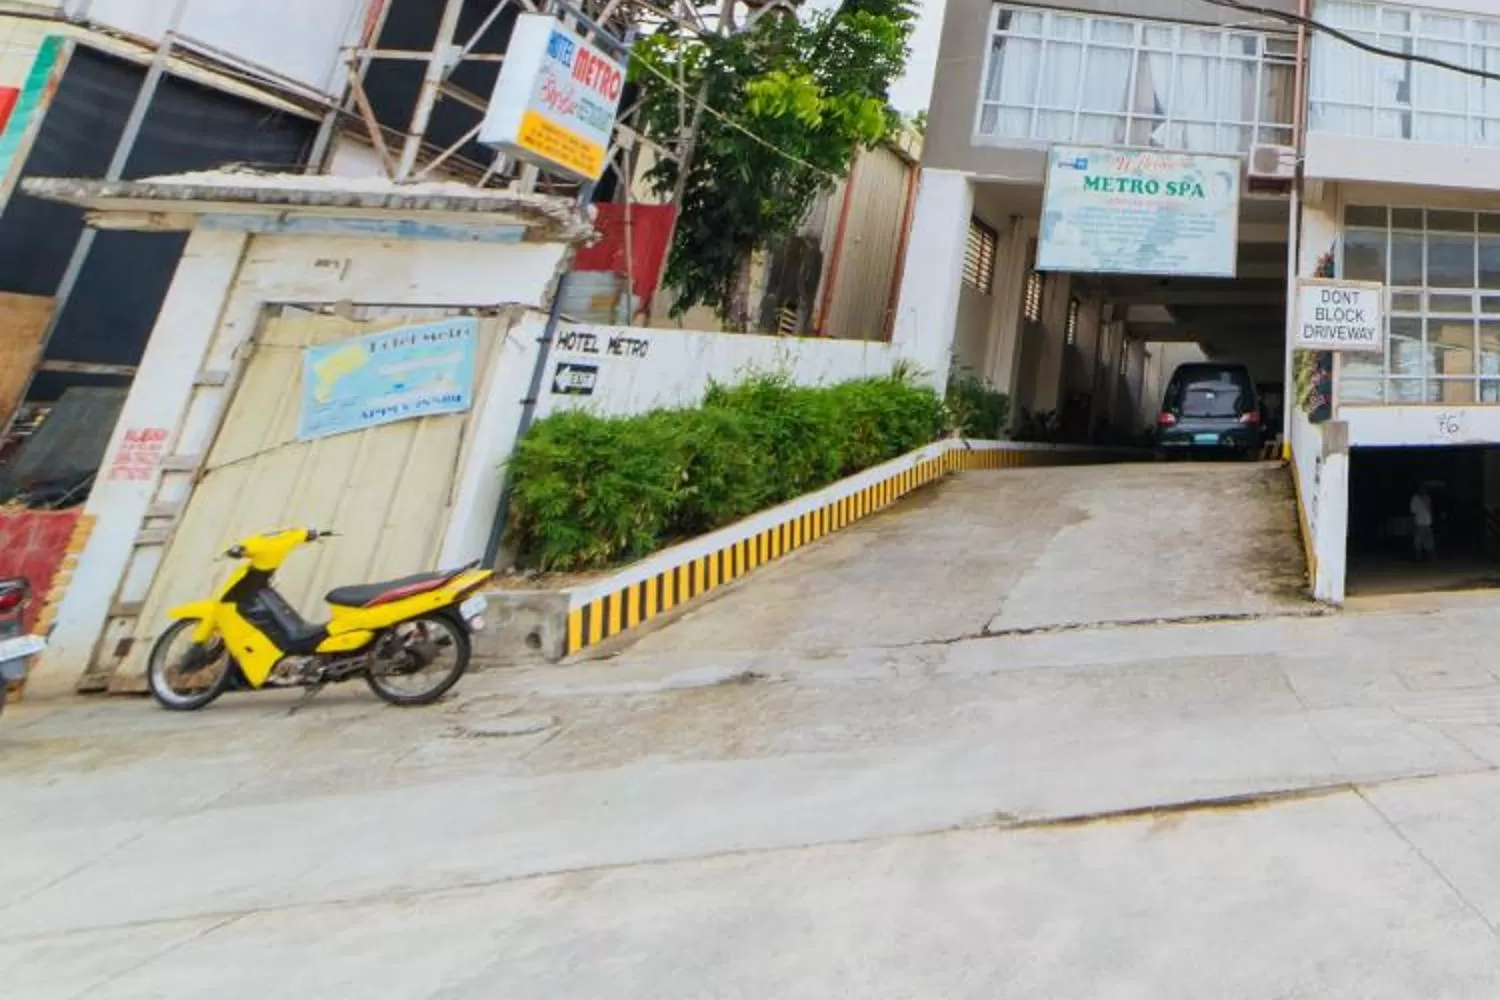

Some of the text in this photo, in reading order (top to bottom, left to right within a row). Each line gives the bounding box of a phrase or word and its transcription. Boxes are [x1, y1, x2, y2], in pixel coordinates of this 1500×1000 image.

[571, 47, 622, 101] METRO
[1083, 176, 1205, 198] METRO SPA
[1321, 289, 1360, 305] DONT
[1315, 307, 1365, 323] BLOCK
[1303, 324, 1376, 341] DRIVEWAY
[556, 330, 651, 359] HOTEL METRO
